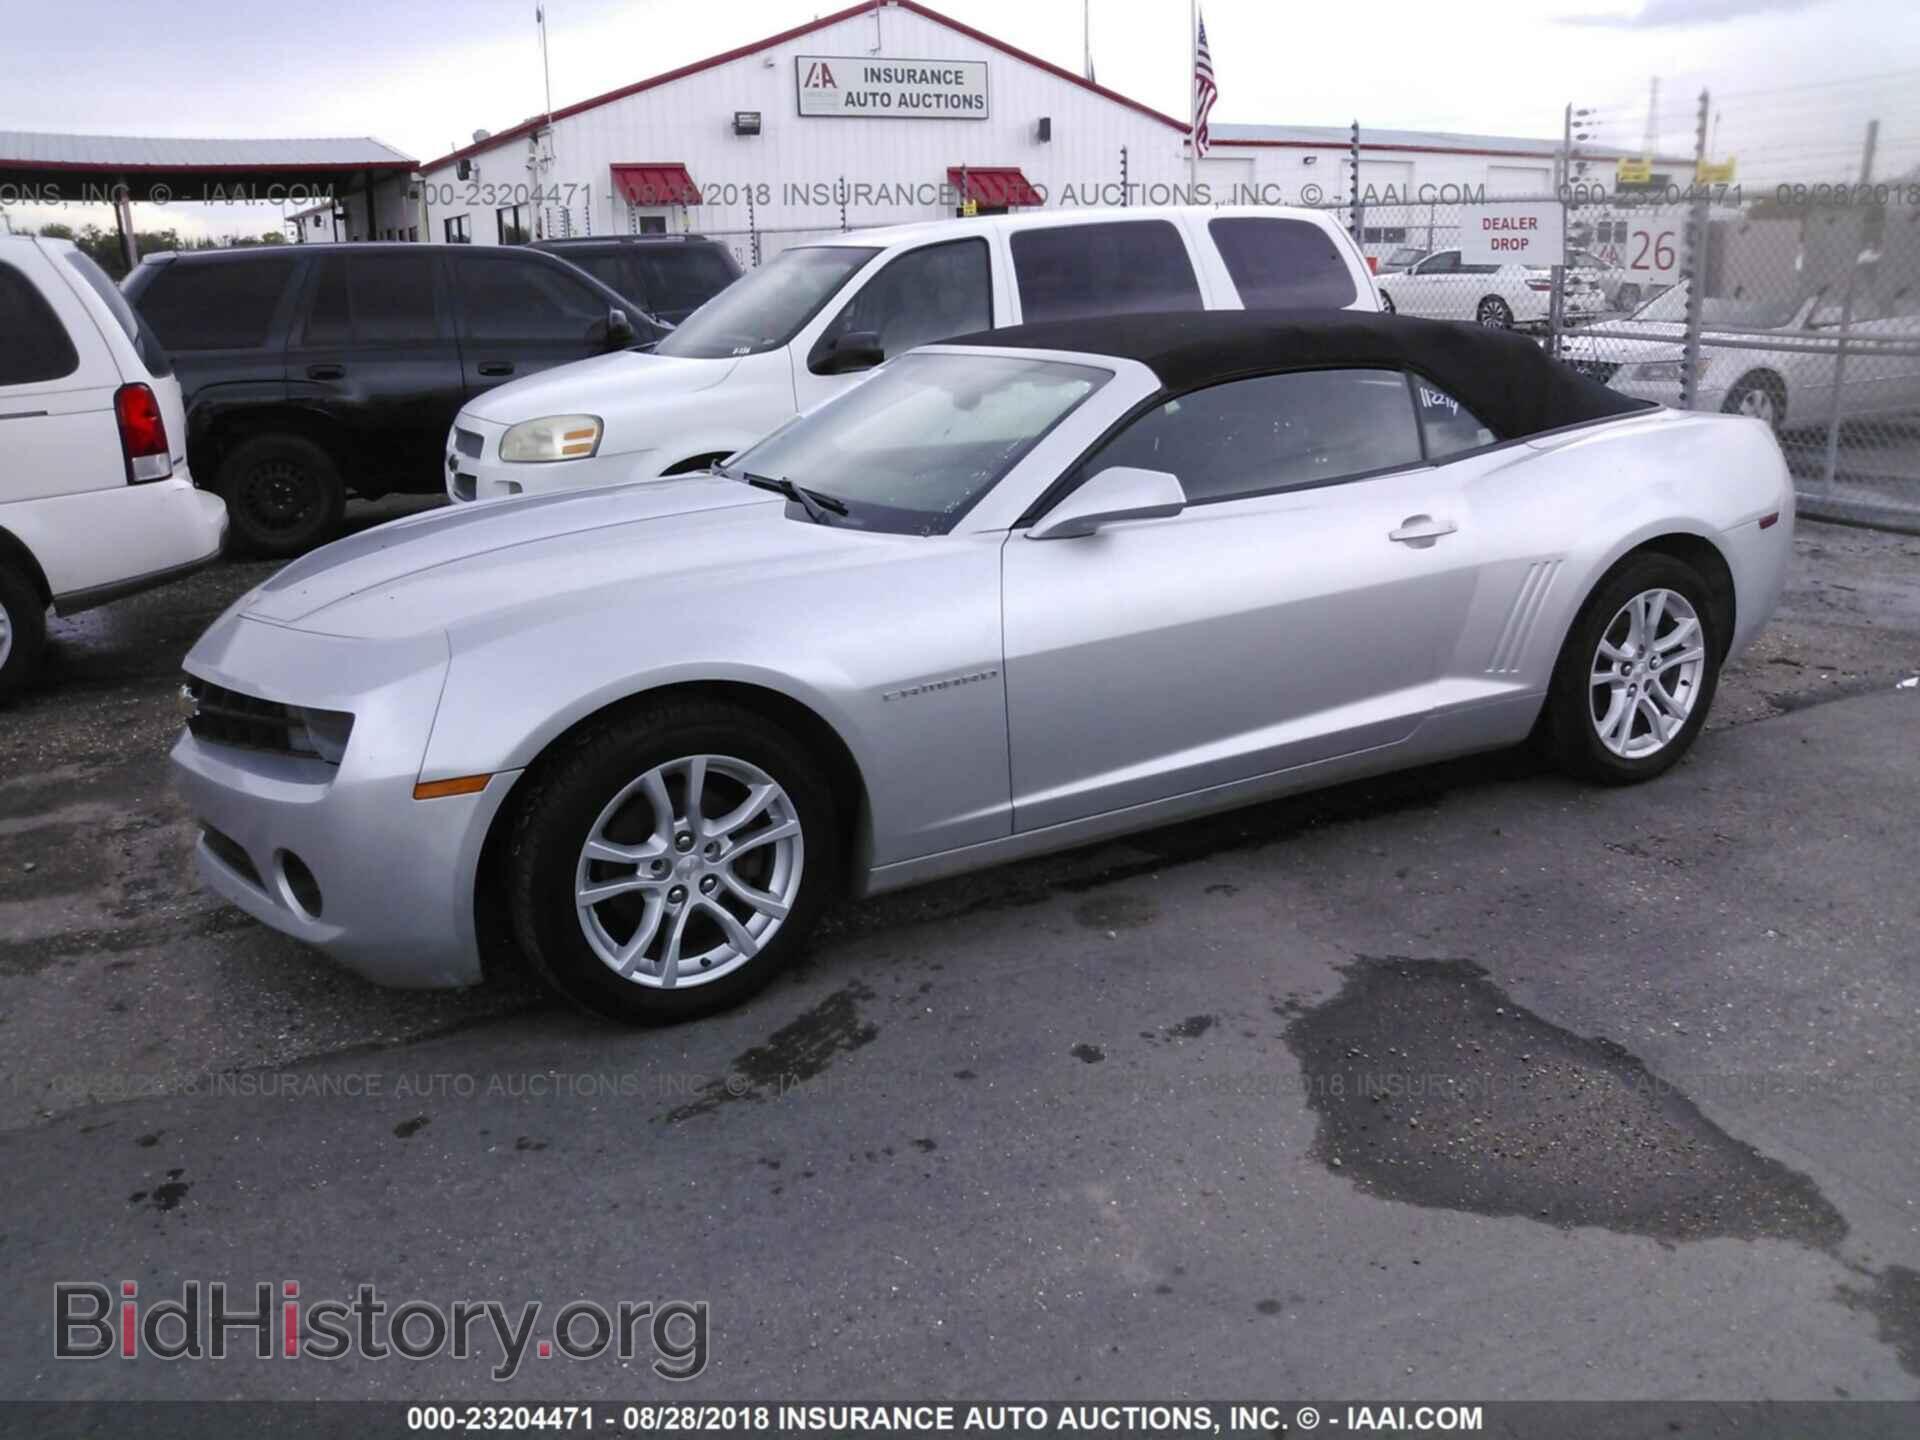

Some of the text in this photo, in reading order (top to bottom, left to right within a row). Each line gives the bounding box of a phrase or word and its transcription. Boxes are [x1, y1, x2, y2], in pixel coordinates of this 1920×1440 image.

[863, 66, 965, 85] INSURANCE
[844, 91, 892, 108] AUTO
[897, 92, 985, 110] AUCTIONS
[1482, 217, 1538, 231] DEALER
[1491, 238, 1529, 250] DROP
[1630, 231, 1676, 271] 26
